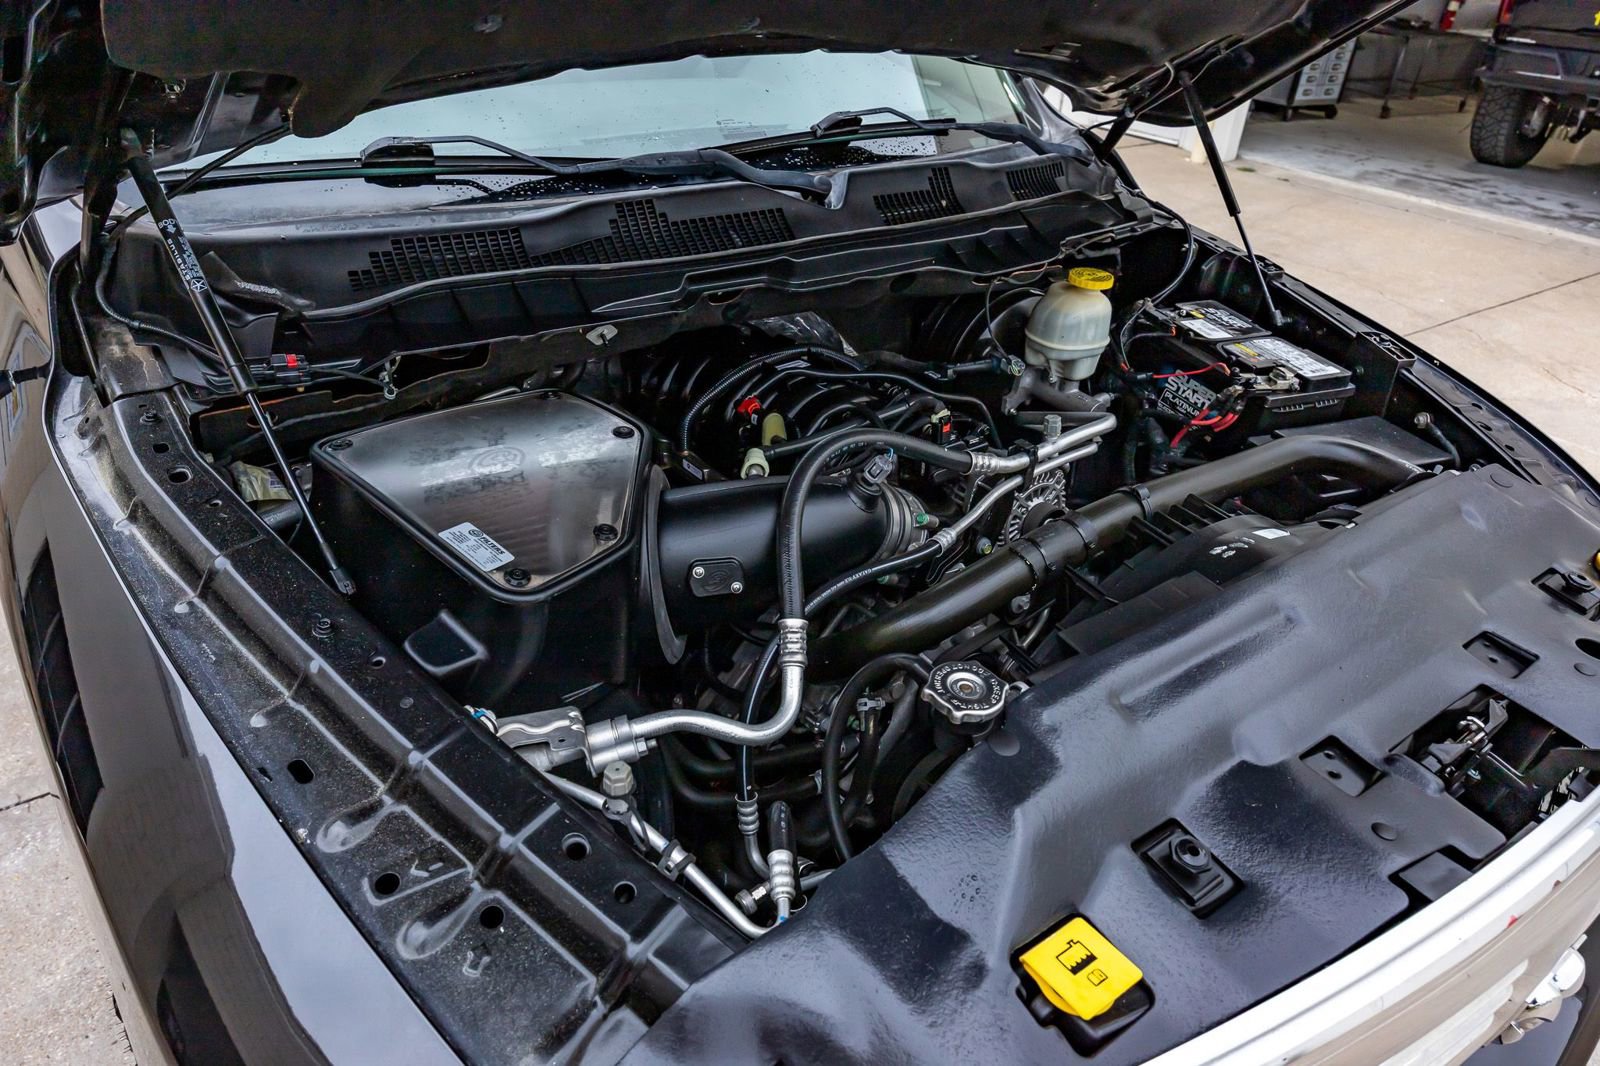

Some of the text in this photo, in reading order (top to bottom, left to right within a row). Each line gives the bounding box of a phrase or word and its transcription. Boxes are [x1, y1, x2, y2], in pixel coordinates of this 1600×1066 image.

[158, 219, 177, 229] BOD
[167, 238, 191, 281] STABILUS
[1165, 376, 1211, 410] START
[1175, 369, 1217, 403] SUPER
